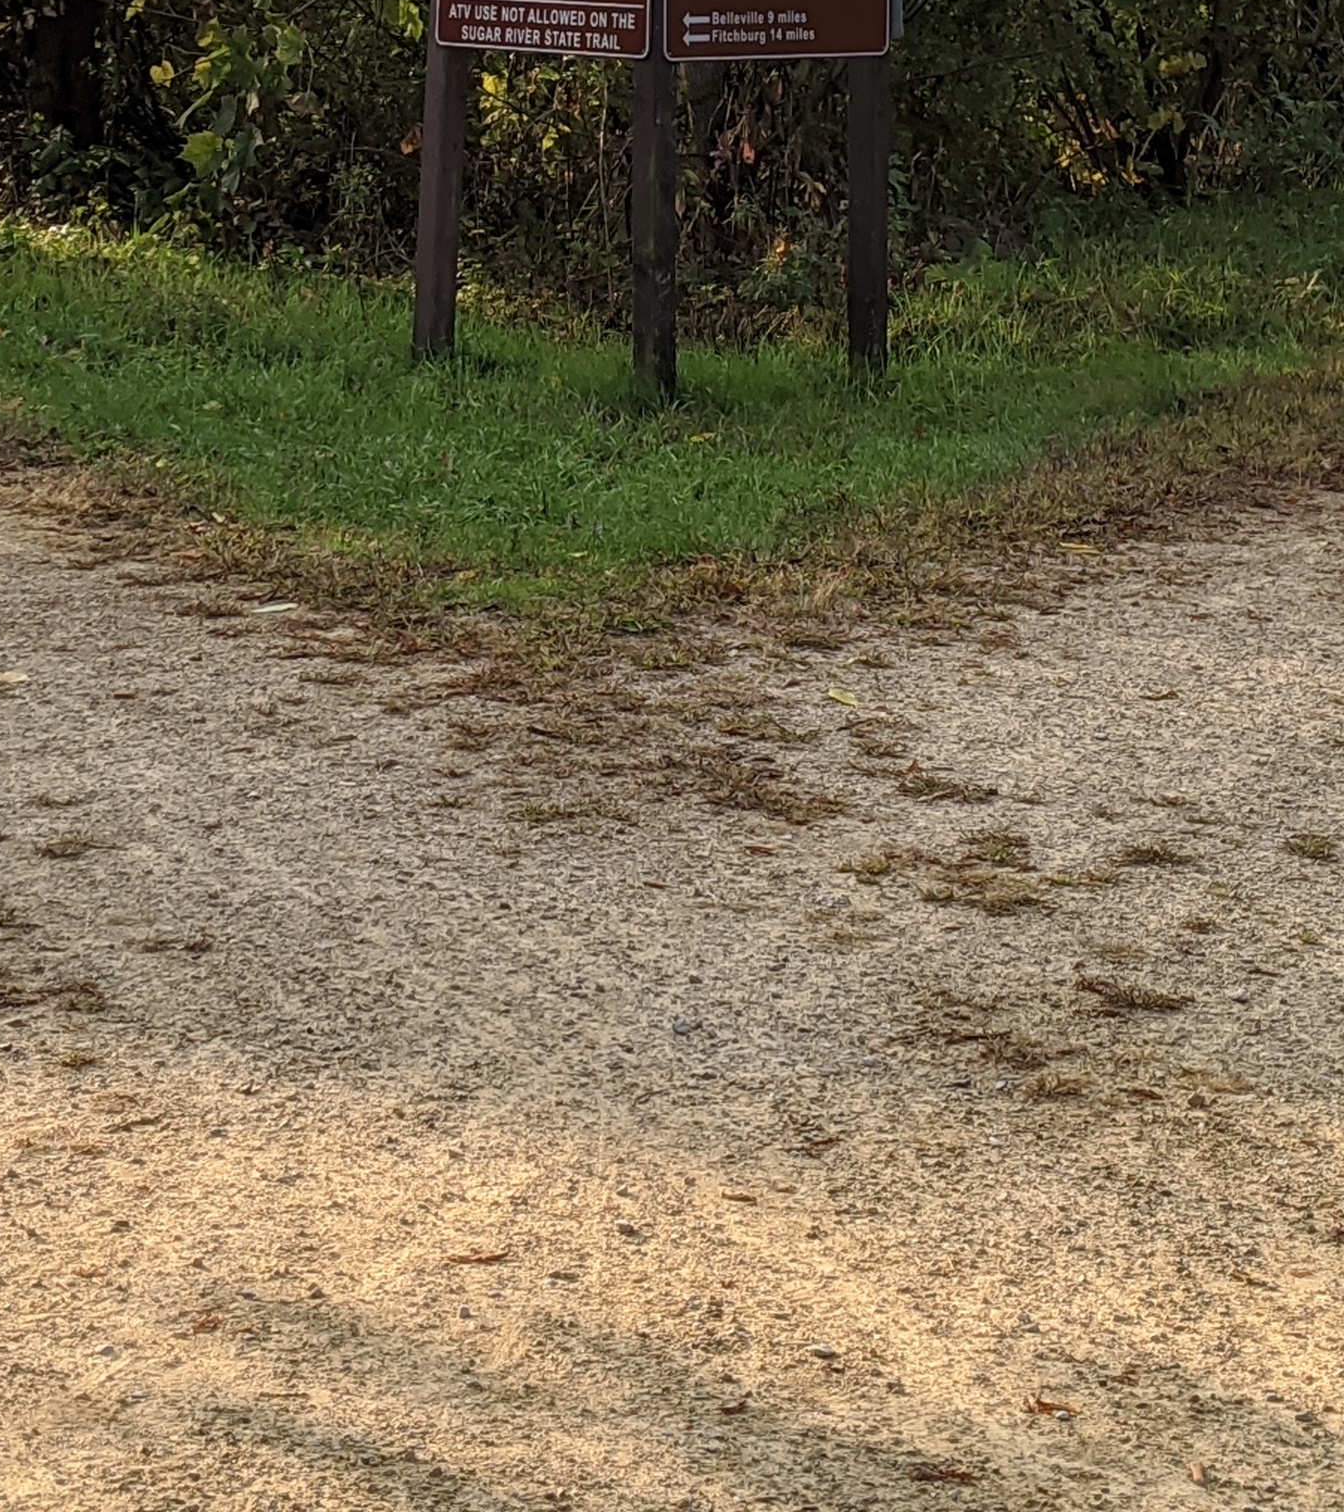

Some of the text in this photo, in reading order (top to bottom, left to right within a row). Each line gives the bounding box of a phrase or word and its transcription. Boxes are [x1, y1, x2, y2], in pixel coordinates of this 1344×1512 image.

[449, 4, 635, 29] ATV USE NOT ALLOWED ON THE
[712, 11, 807, 25] Belleville 9 miles
[461, 25, 620, 50] SUGAR RIVER STATE TRAIL
[712, 28, 815, 44] Fitchburg 14 miles
